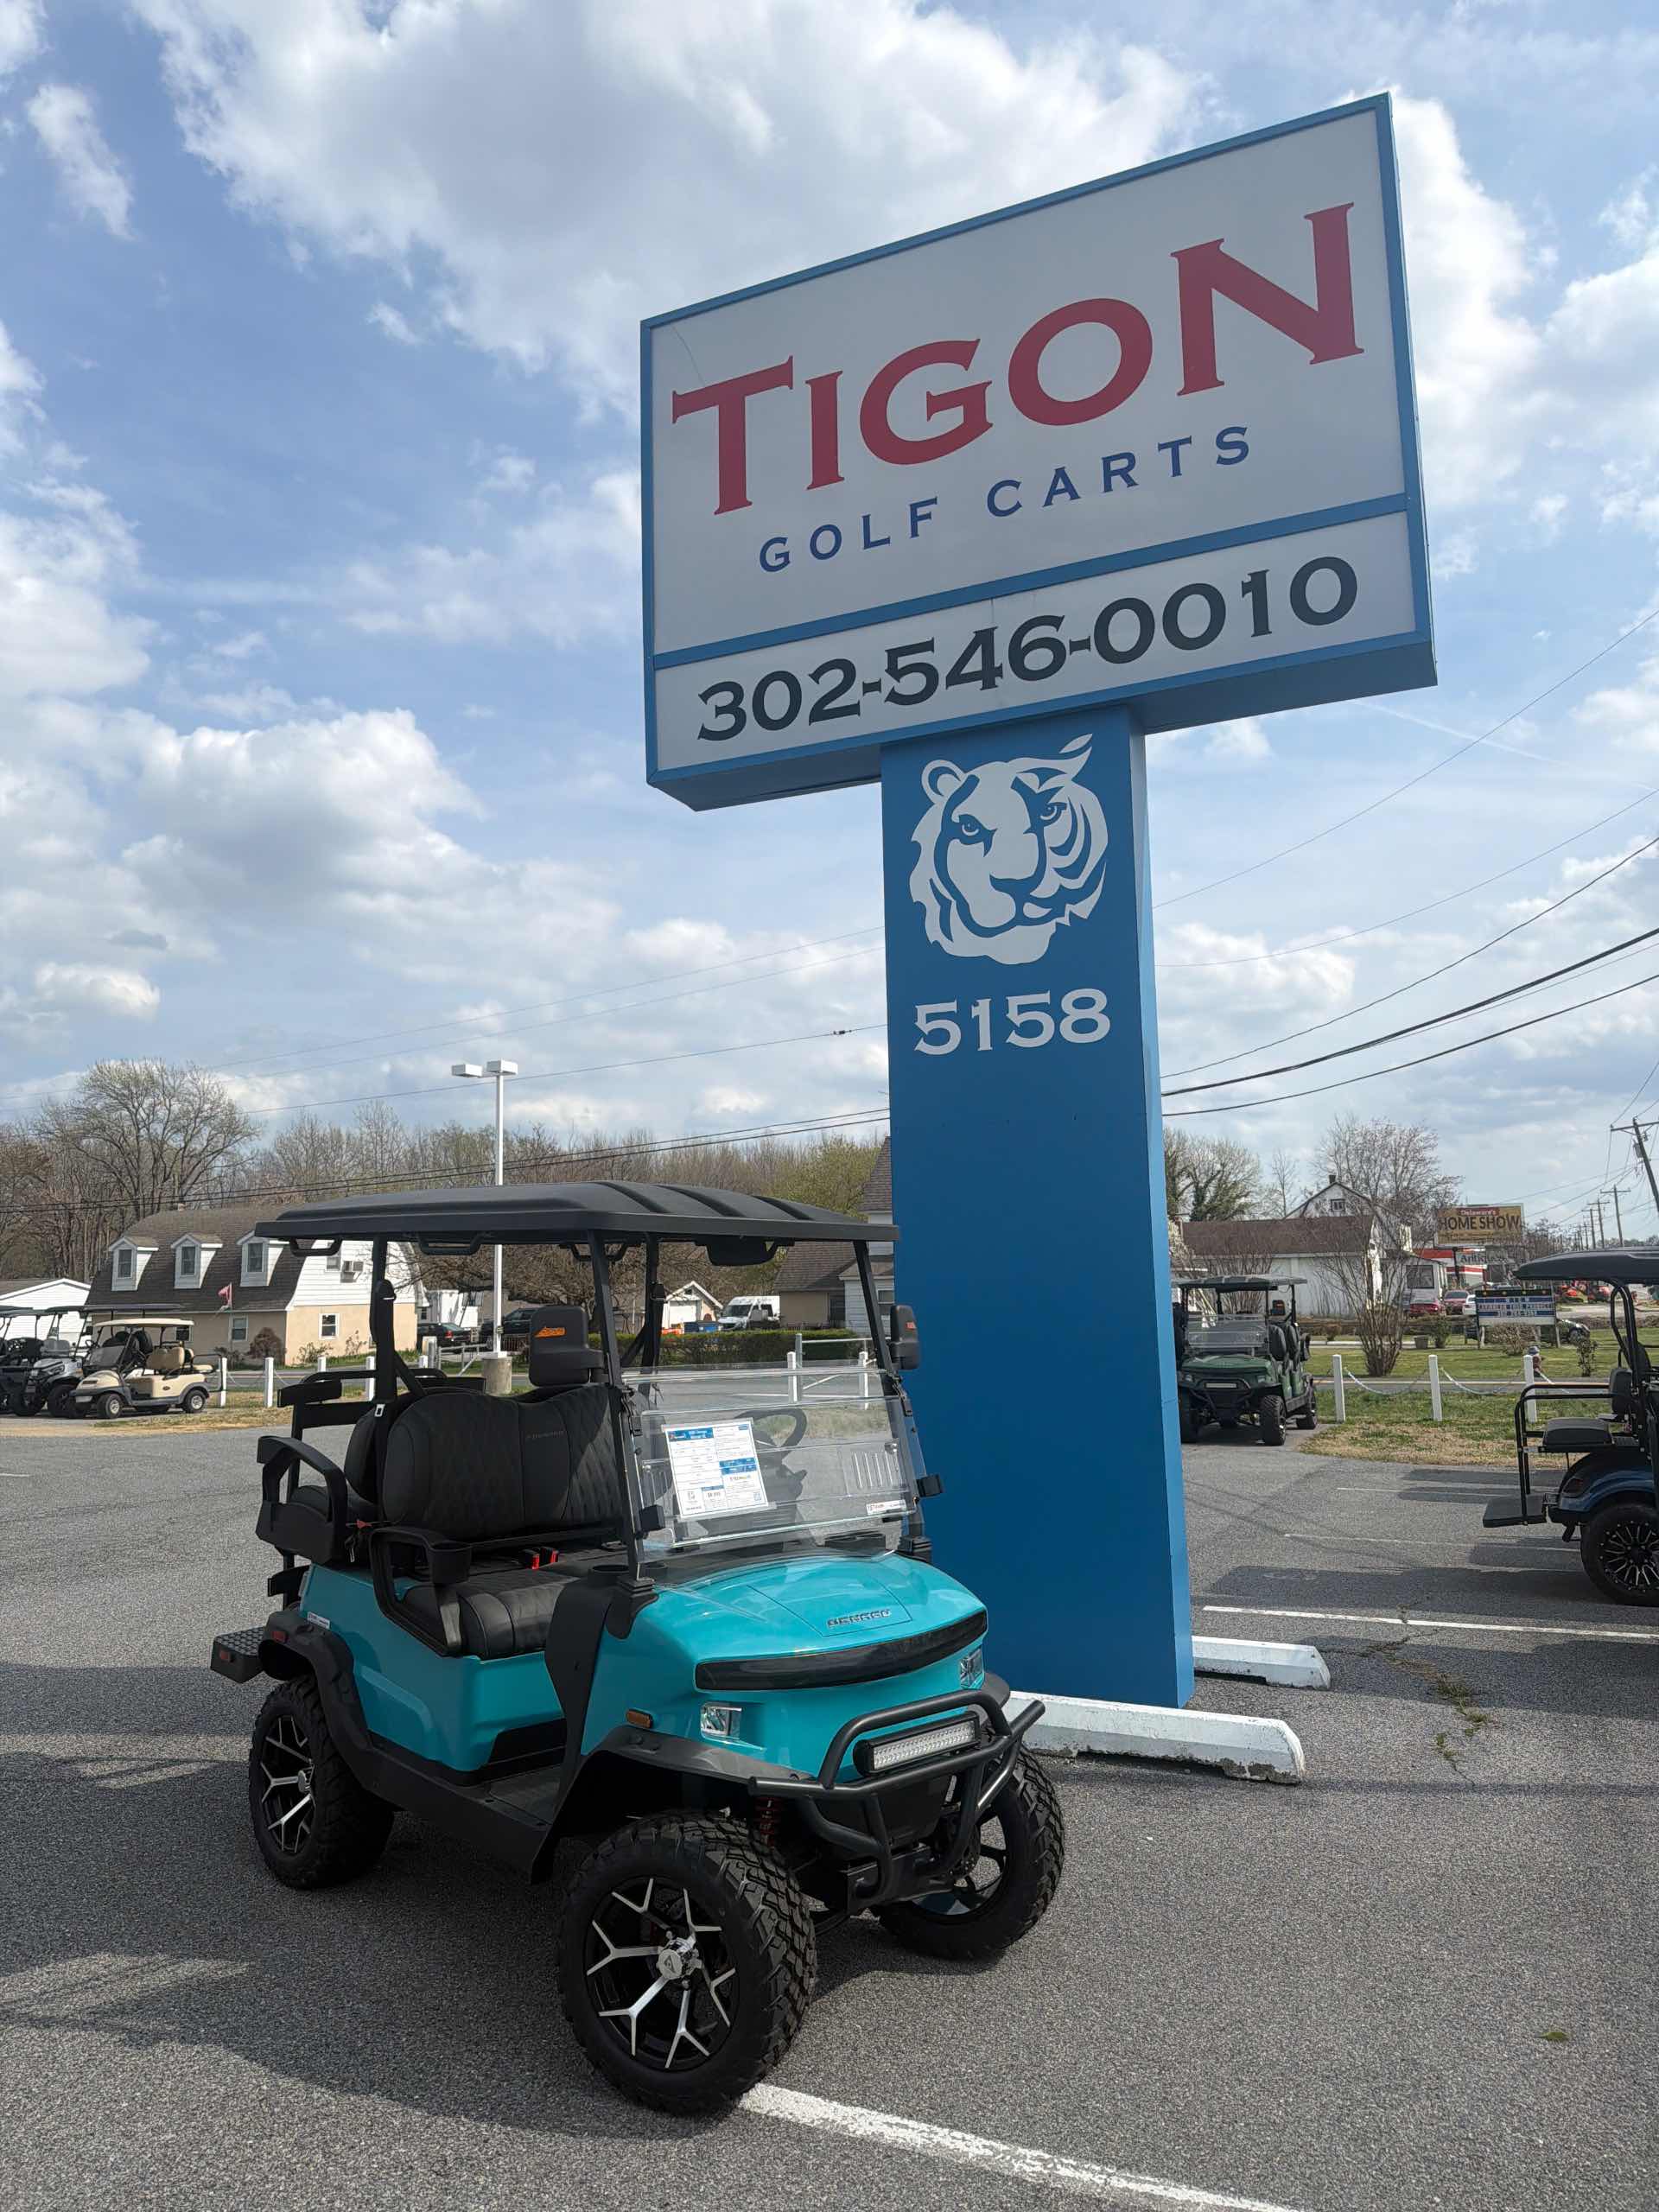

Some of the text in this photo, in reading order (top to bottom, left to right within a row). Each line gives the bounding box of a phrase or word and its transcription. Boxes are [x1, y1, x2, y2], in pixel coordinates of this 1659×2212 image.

[671, 202, 1364, 516] TIGON
[759, 426, 1250, 573] GOLF CARTS
[696, 556, 1358, 742] 302-546-0010
[914, 988, 1111, 1055] 5158
[1439, 1215, 1521, 1230] HOME SHOW
